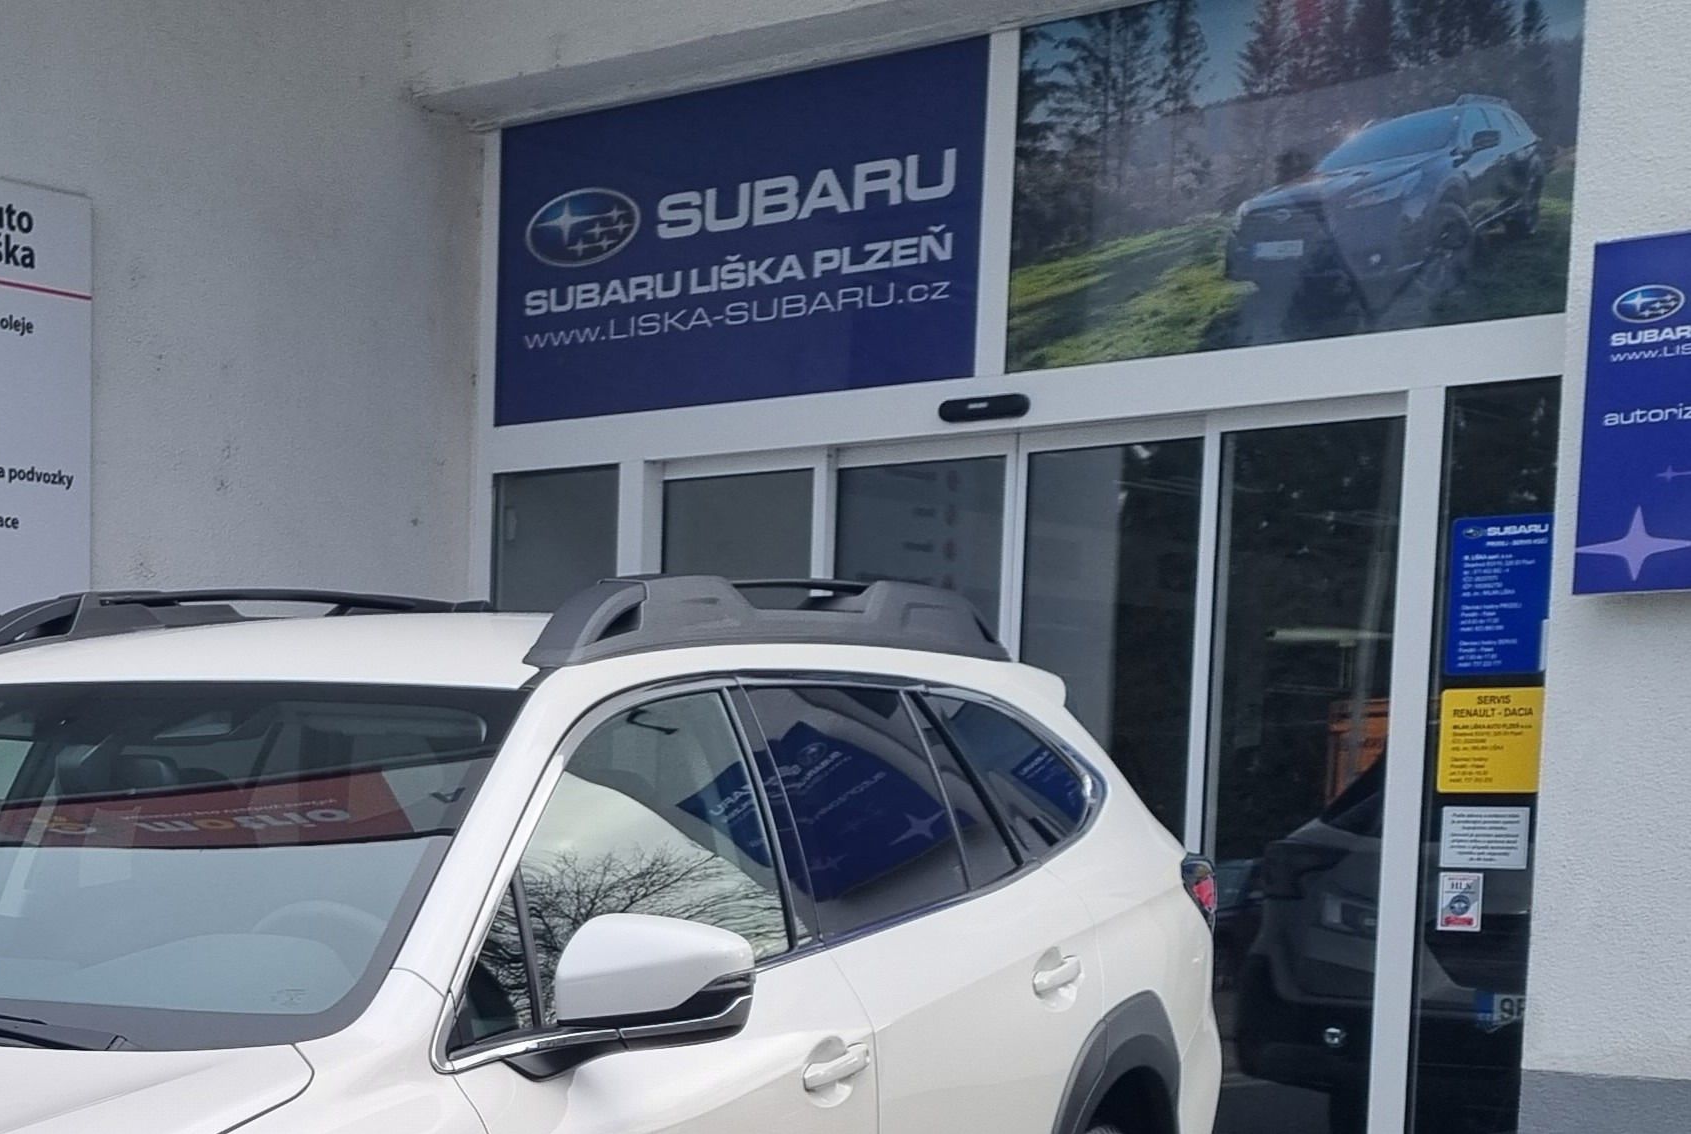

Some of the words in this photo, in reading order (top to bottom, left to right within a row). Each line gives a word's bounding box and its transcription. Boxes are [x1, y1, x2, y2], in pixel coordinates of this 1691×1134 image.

[656, 147, 958, 240] SUBARU
[524, 269, 682, 317] SUBARU
[689, 254, 805, 296] LIŠKA
[813, 225, 953, 279] PLZEŇ
[0, 315, 34, 337] oleje
[524, 280, 951, 350] www.LISKA-SUBARU.cz
[8, 466, 74, 490] podvozky
[1487, 524, 1549, 537] SUBARU
[1477, 695, 1512, 705] SERVIS
[1452, 708, 1496, 718] RENAULT
[1503, 707, 1534, 717] DACIA
